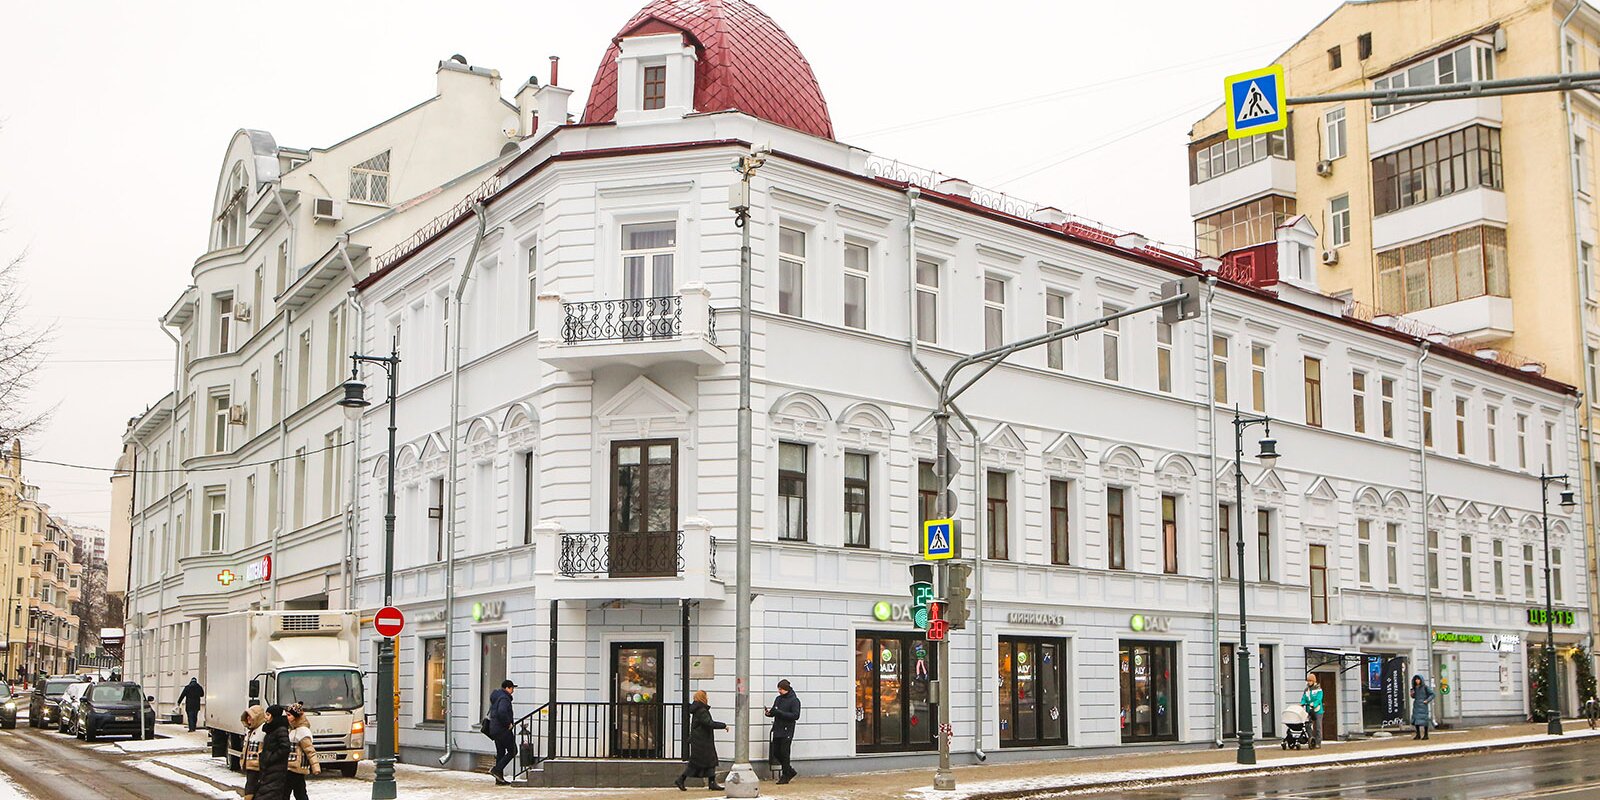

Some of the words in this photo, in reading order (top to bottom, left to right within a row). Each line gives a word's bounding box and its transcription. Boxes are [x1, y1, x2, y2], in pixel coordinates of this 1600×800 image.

[917, 587, 933, 605] 25
[1009, 612, 1066, 625] МИНИМАРКЕТ
[1144, 616, 1173, 631] DAILY
[929, 621, 943, 639] 28
